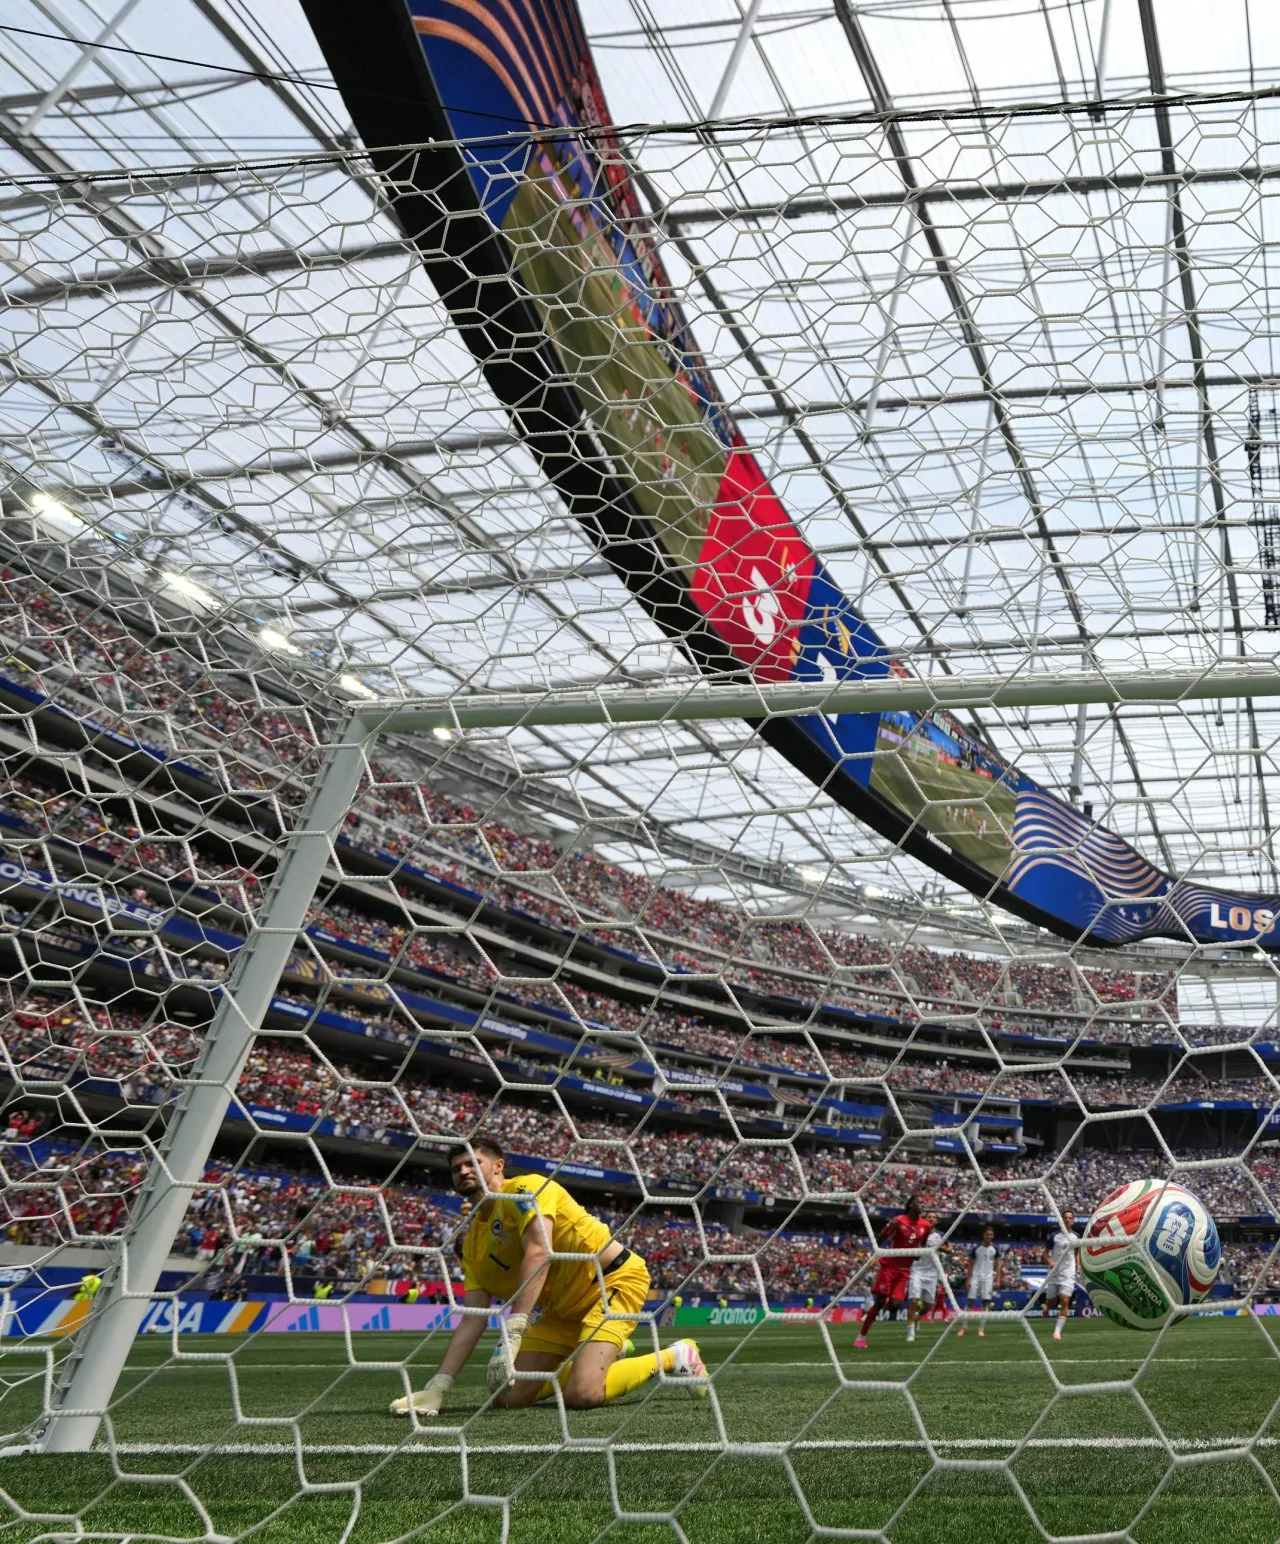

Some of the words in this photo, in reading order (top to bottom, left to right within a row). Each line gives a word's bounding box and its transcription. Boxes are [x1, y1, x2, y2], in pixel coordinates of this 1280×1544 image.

[1210, 903, 1275, 934] LOS
[671, 1070, 700, 1084] WORLD
[1162, 1242, 1174, 1251] FIFA
[489, 1253, 511, 1271] 1
[1131, 1269, 1163, 1308] TRIONDA
[710, 1307, 756, 1325] aramco
